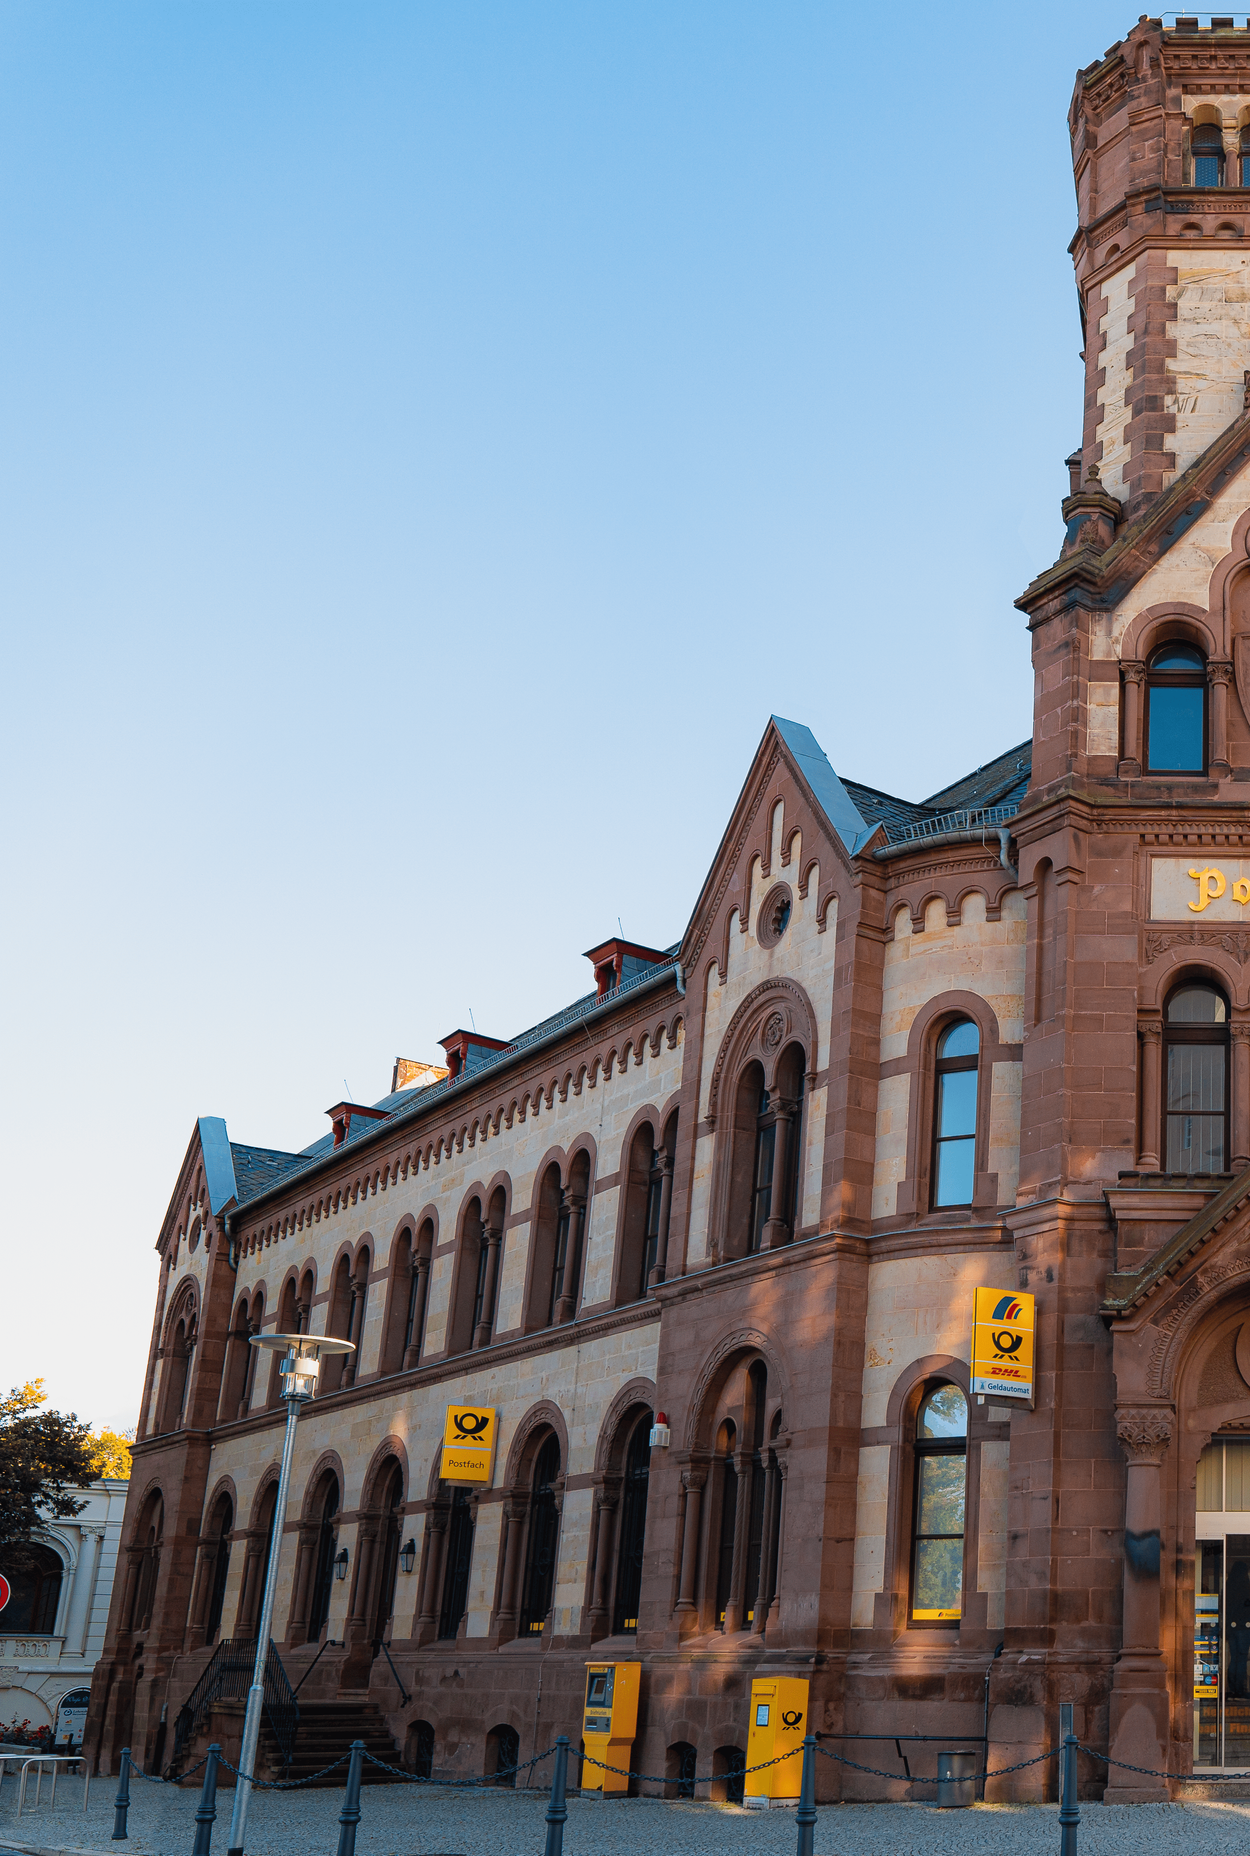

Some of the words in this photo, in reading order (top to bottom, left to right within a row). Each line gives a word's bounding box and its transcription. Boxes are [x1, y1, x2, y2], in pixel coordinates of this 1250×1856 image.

[990, 1367, 1021, 1378] DHL
[987, 1382, 1030, 1395] Geldautomat
[448, 1459, 485, 1469] Postfach
